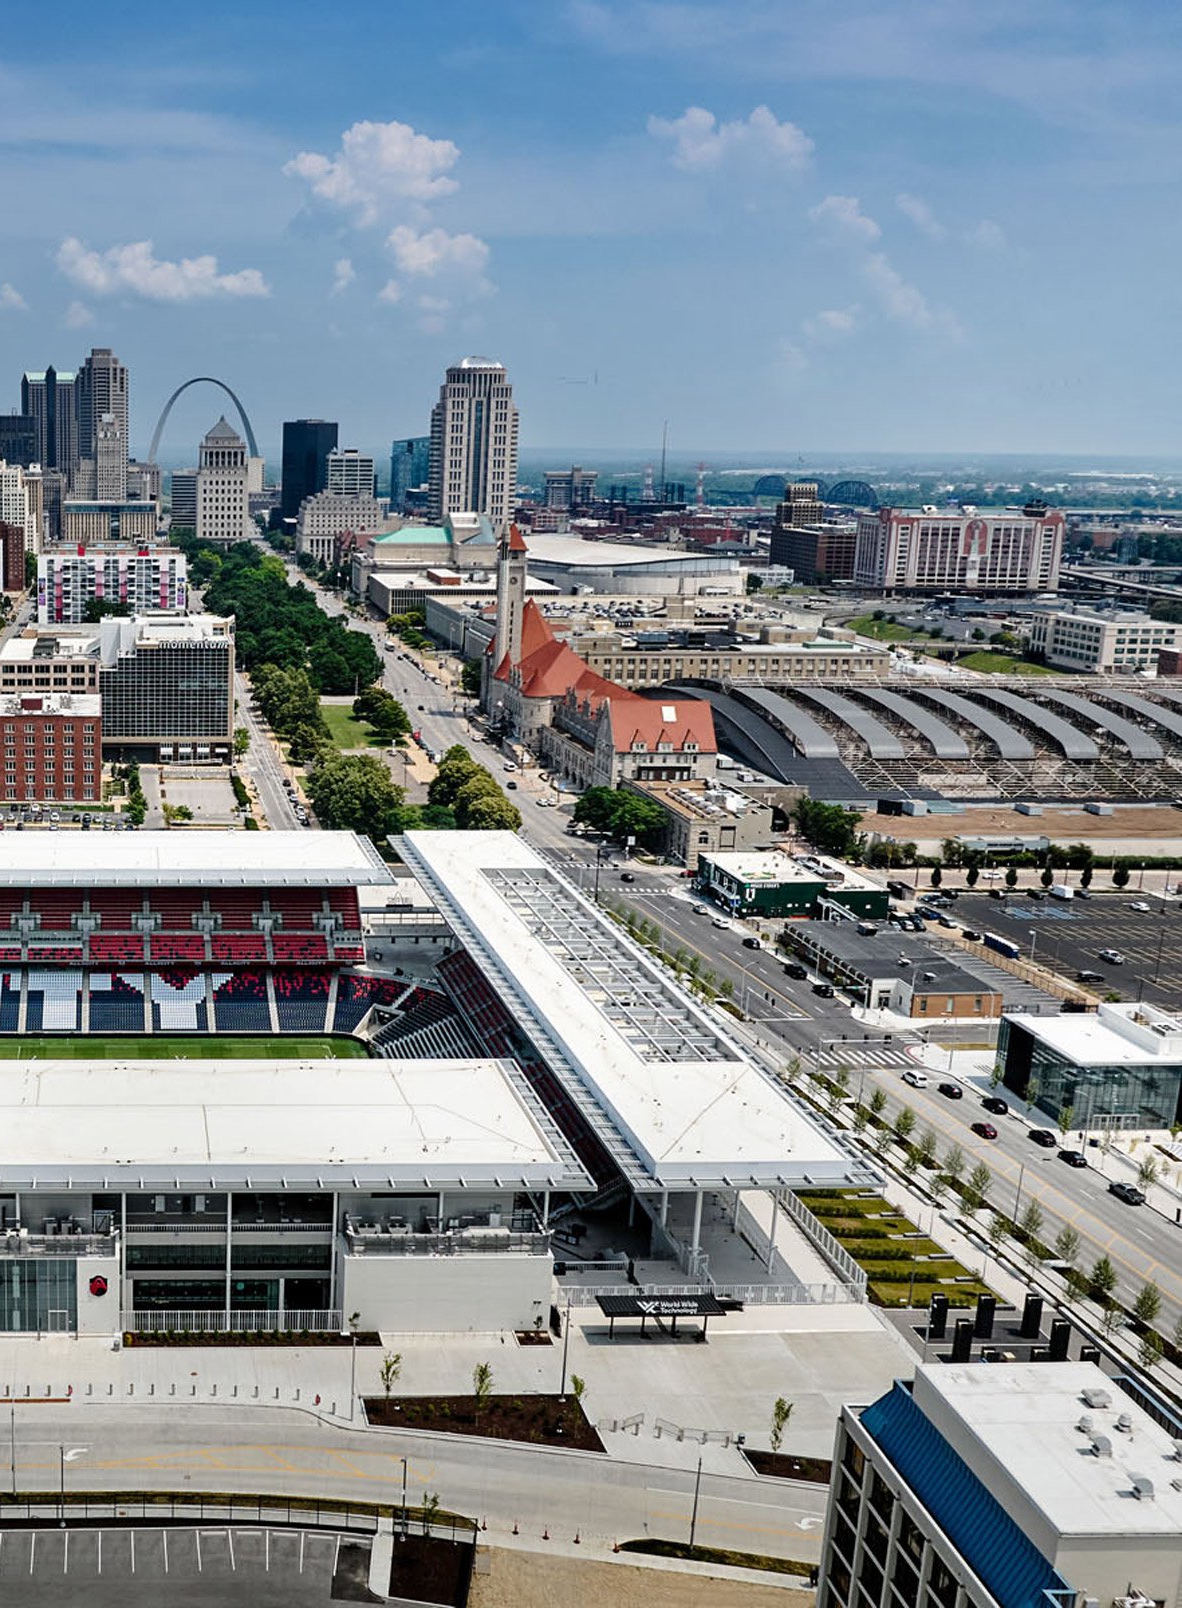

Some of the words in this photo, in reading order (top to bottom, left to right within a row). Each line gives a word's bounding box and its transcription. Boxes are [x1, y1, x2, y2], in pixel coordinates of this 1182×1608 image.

[159, 638, 228, 649] momentum
[660, 1301, 681, 1309] World
[681, 1301, 699, 1309] Wide
